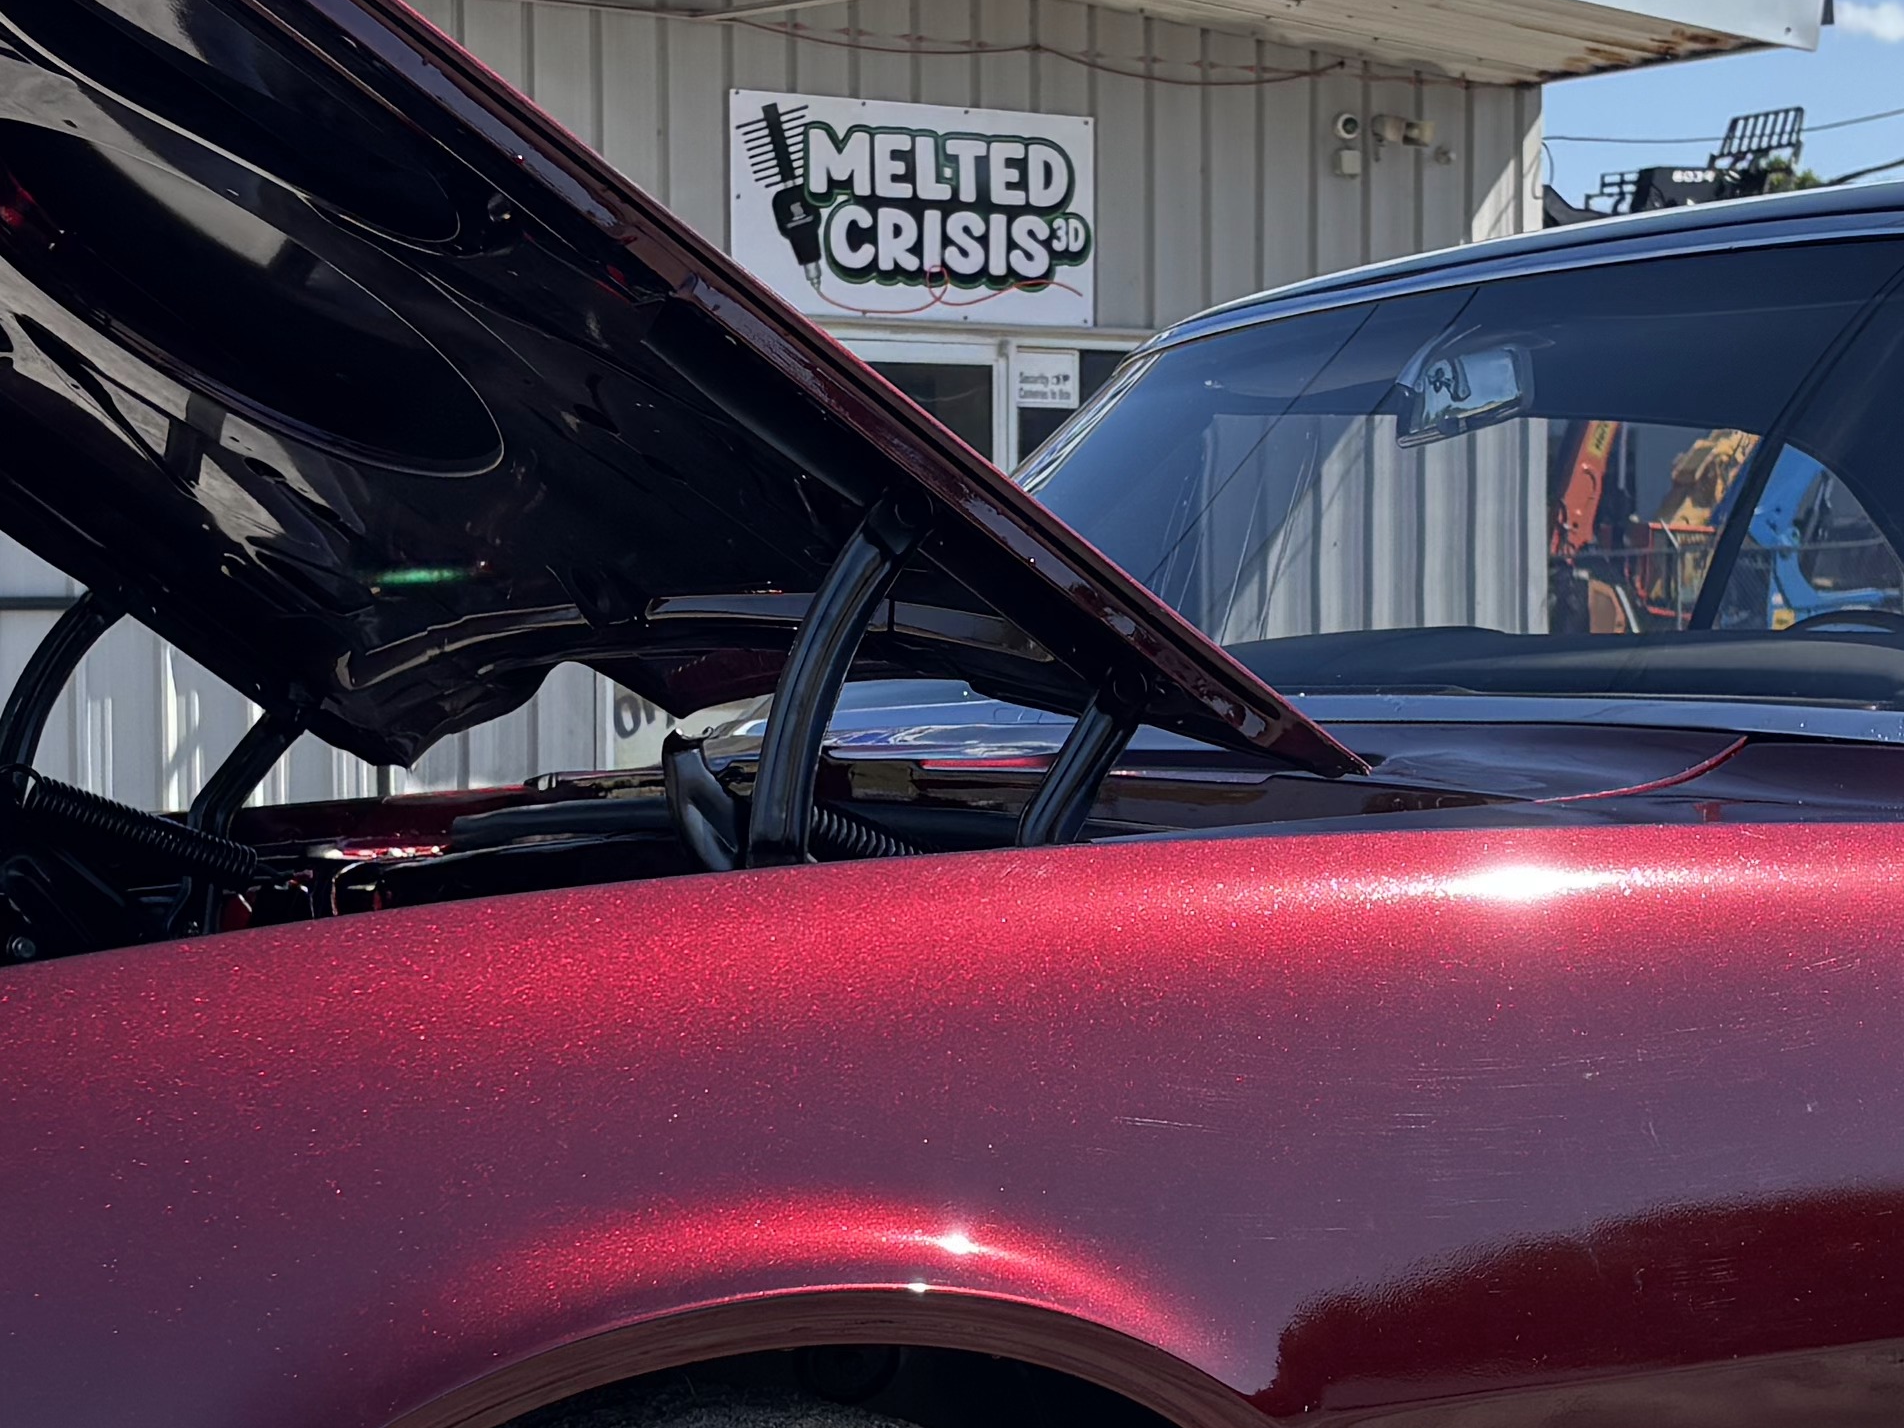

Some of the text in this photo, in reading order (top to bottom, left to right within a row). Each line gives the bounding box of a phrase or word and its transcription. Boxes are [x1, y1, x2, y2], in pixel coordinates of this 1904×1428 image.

[808, 128, 1069, 208] MELTED
[829, 207, 1086, 278] CRISIS 3D
